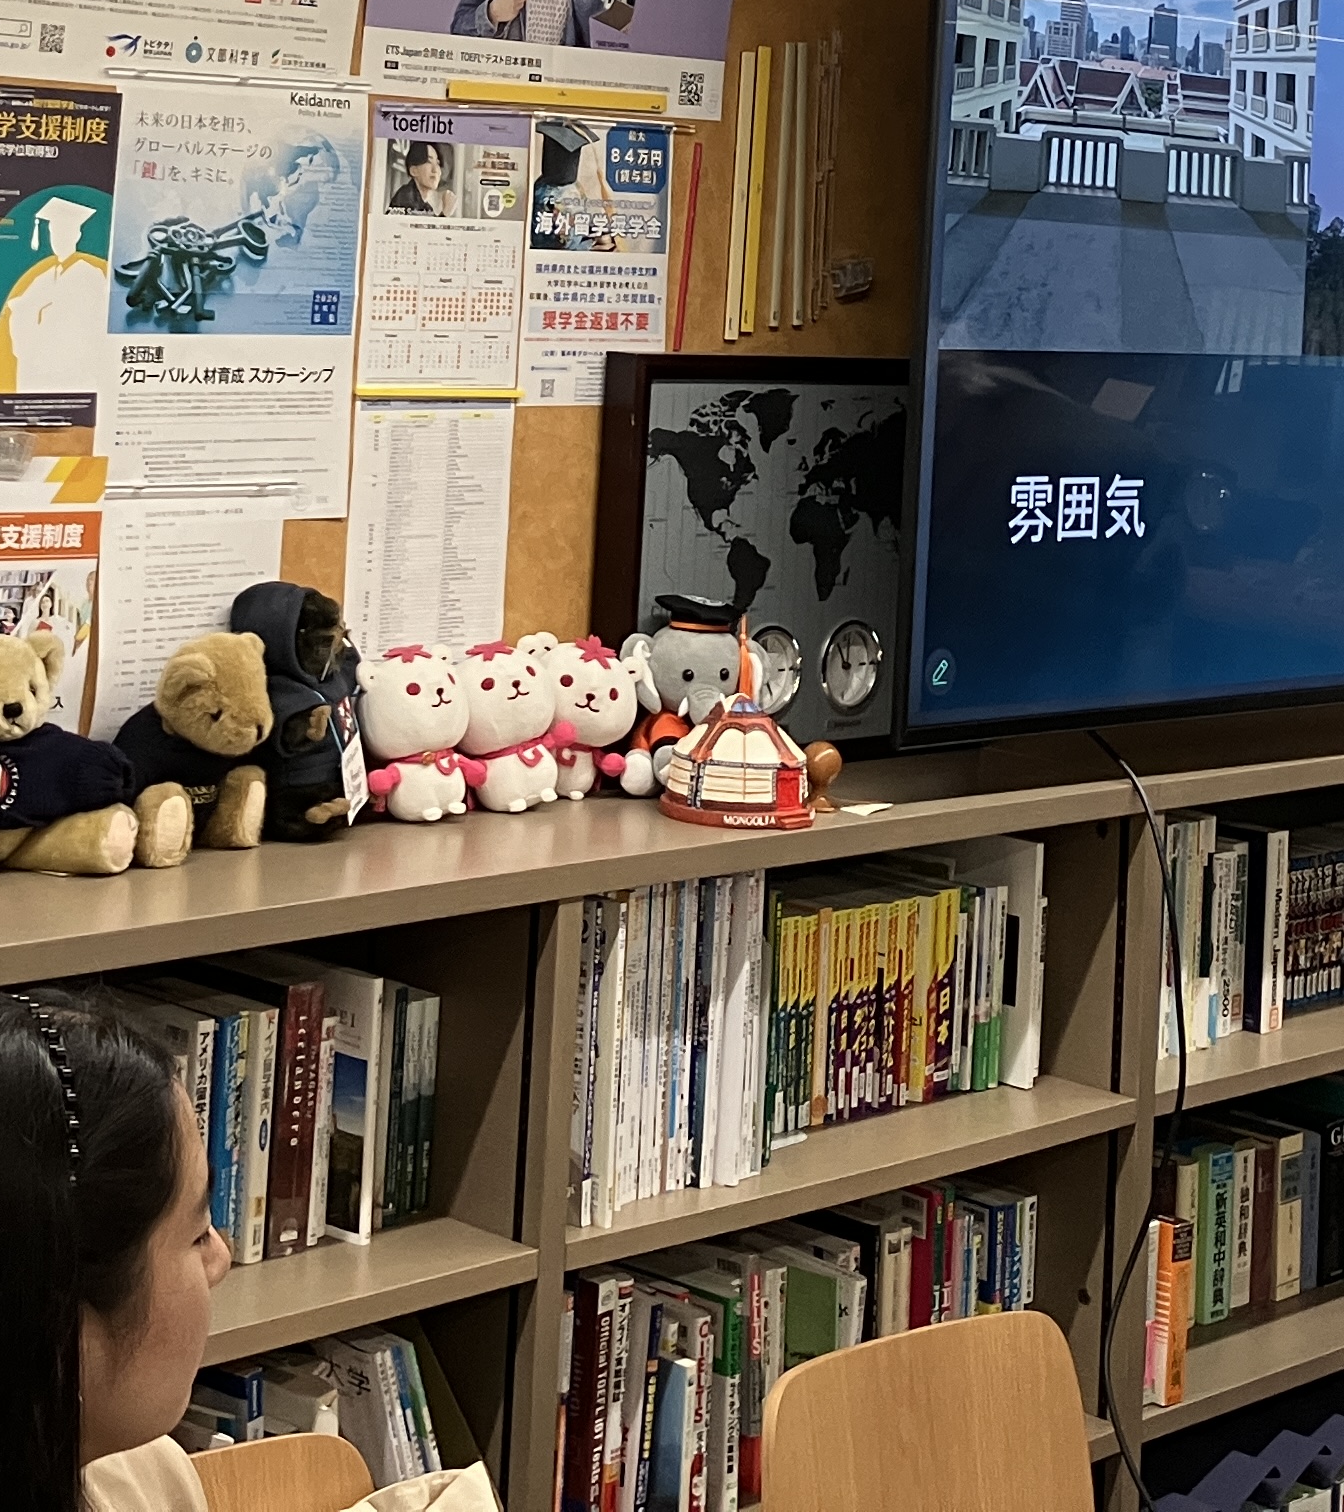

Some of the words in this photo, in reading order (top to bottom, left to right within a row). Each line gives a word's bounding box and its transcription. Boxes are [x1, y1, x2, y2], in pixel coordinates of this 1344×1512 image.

[290, 92, 351, 110] Keidanren
[135, 110, 253, 134] 未来の日本を担う、
[134, 137, 273, 160] グローバルステージの
[121, 346, 165, 364] 経団連
[120, 366, 245, 385] グローバル人材育成
[248, 367, 336, 385] スカラーシップ
[1008, 473, 1146, 544] 雰囲気
[722, 812, 778, 828] MONGOLIA
[1272, 888, 1284, 939] Modern
[751, 1274, 764, 1356] IELTS
